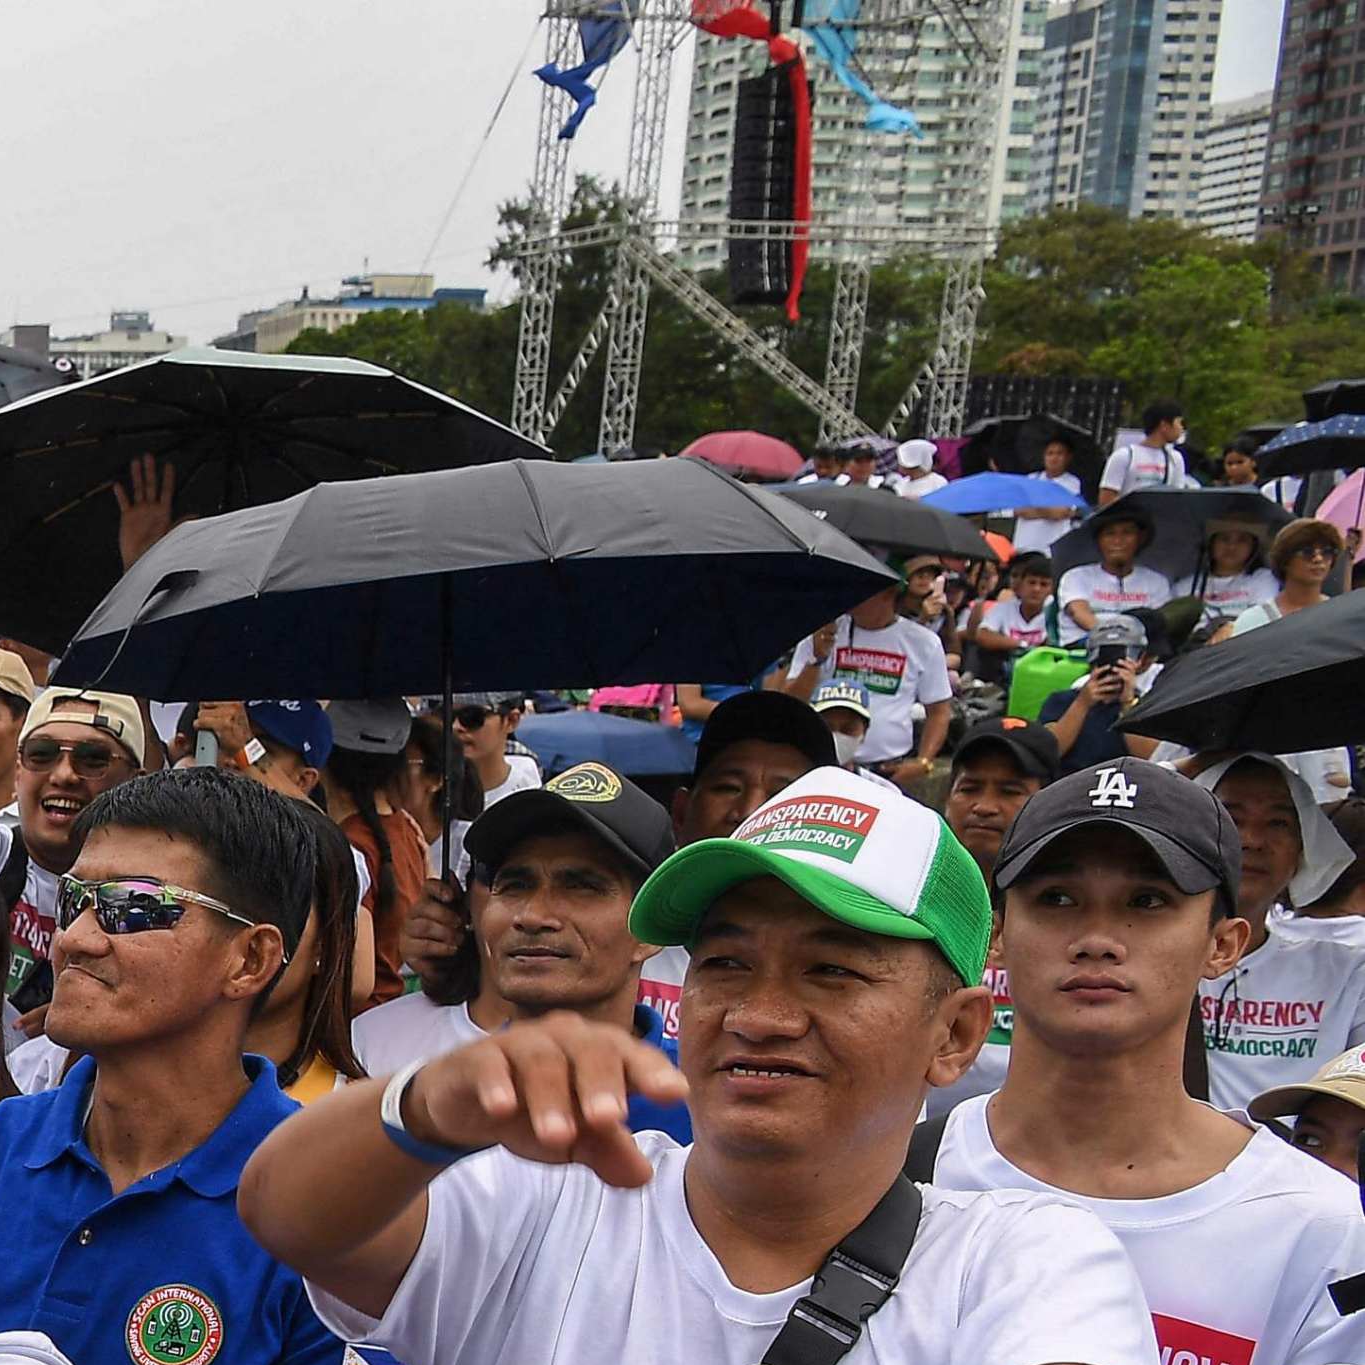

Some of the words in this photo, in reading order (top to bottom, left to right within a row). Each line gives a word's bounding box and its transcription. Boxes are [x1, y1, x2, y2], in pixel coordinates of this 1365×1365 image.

[818, 684, 862, 703] ITALIA
[1088, 767, 1138, 809] LA
[763, 828, 857, 850] DEMOCRACY
[132, 1294, 157, 1323] SCAN
[156, 1287, 220, 1337] INTERNATIONAL
